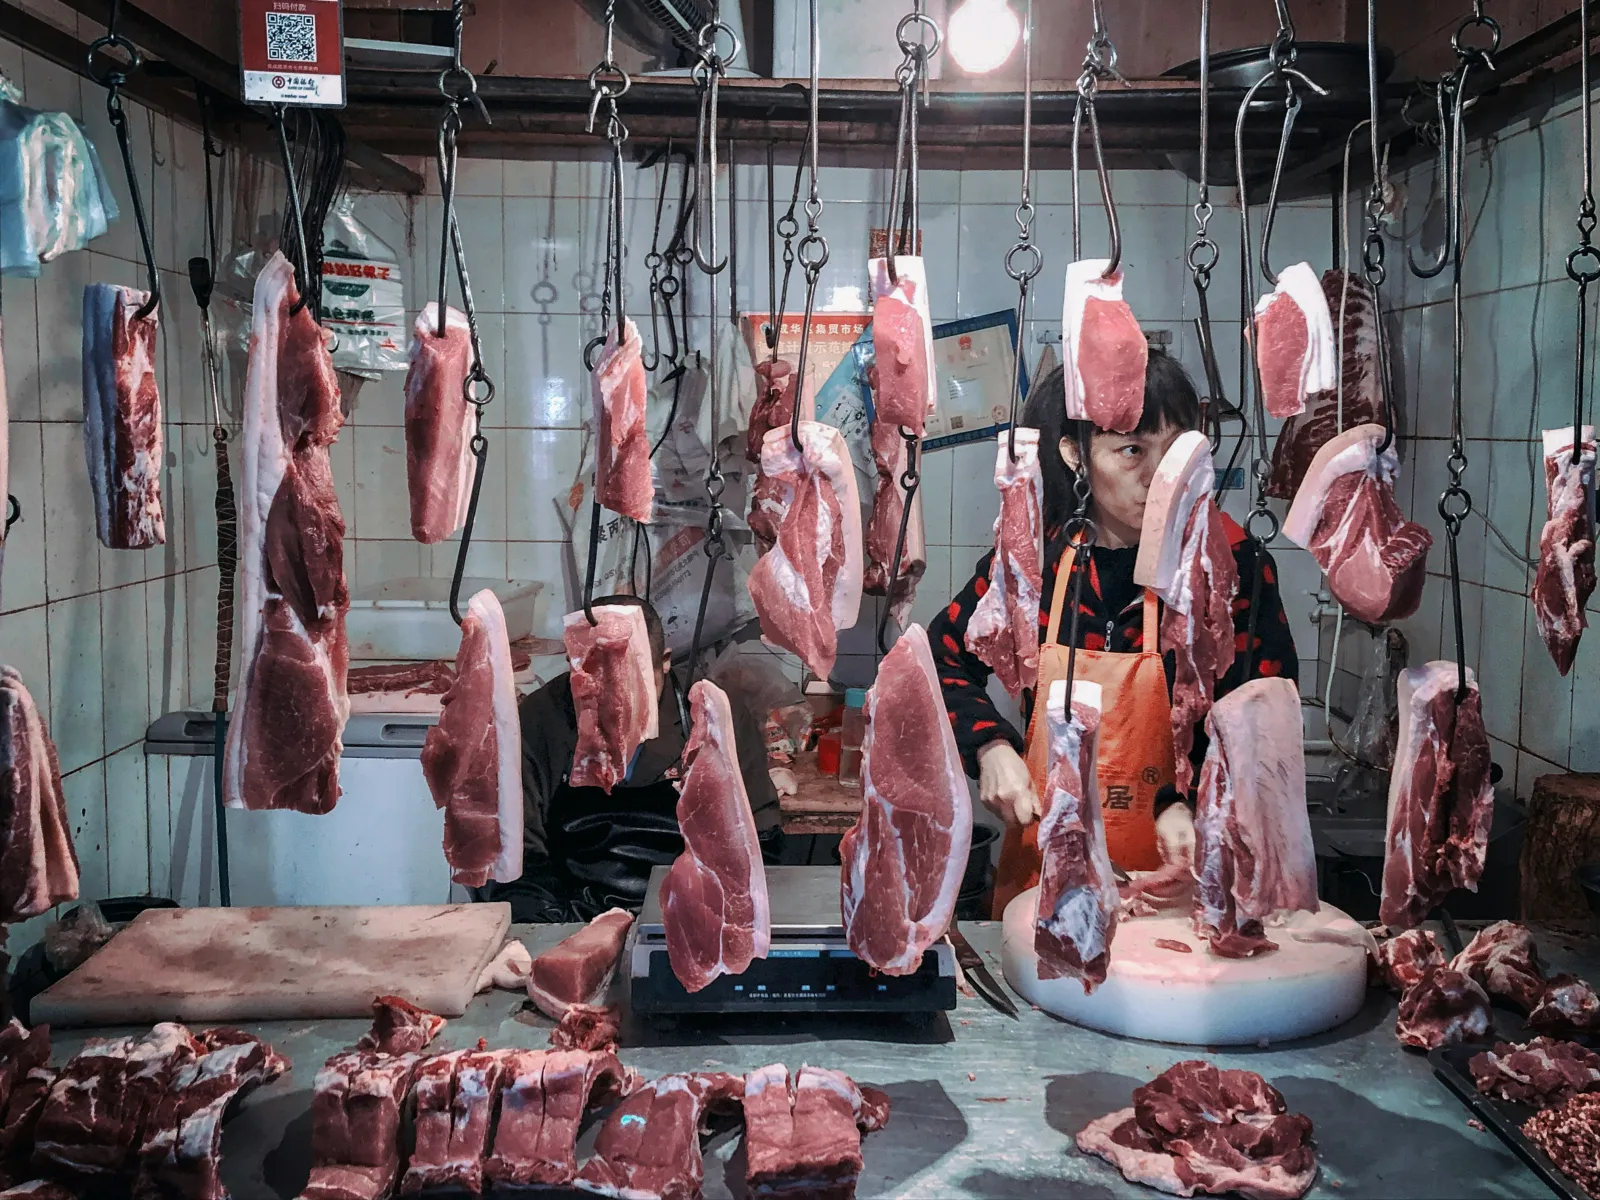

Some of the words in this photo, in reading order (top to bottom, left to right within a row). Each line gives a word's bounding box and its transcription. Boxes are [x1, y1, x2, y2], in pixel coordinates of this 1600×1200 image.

[273, 2, 307, 11] 扫码付款
[287, 77, 315, 87] 中国银行
